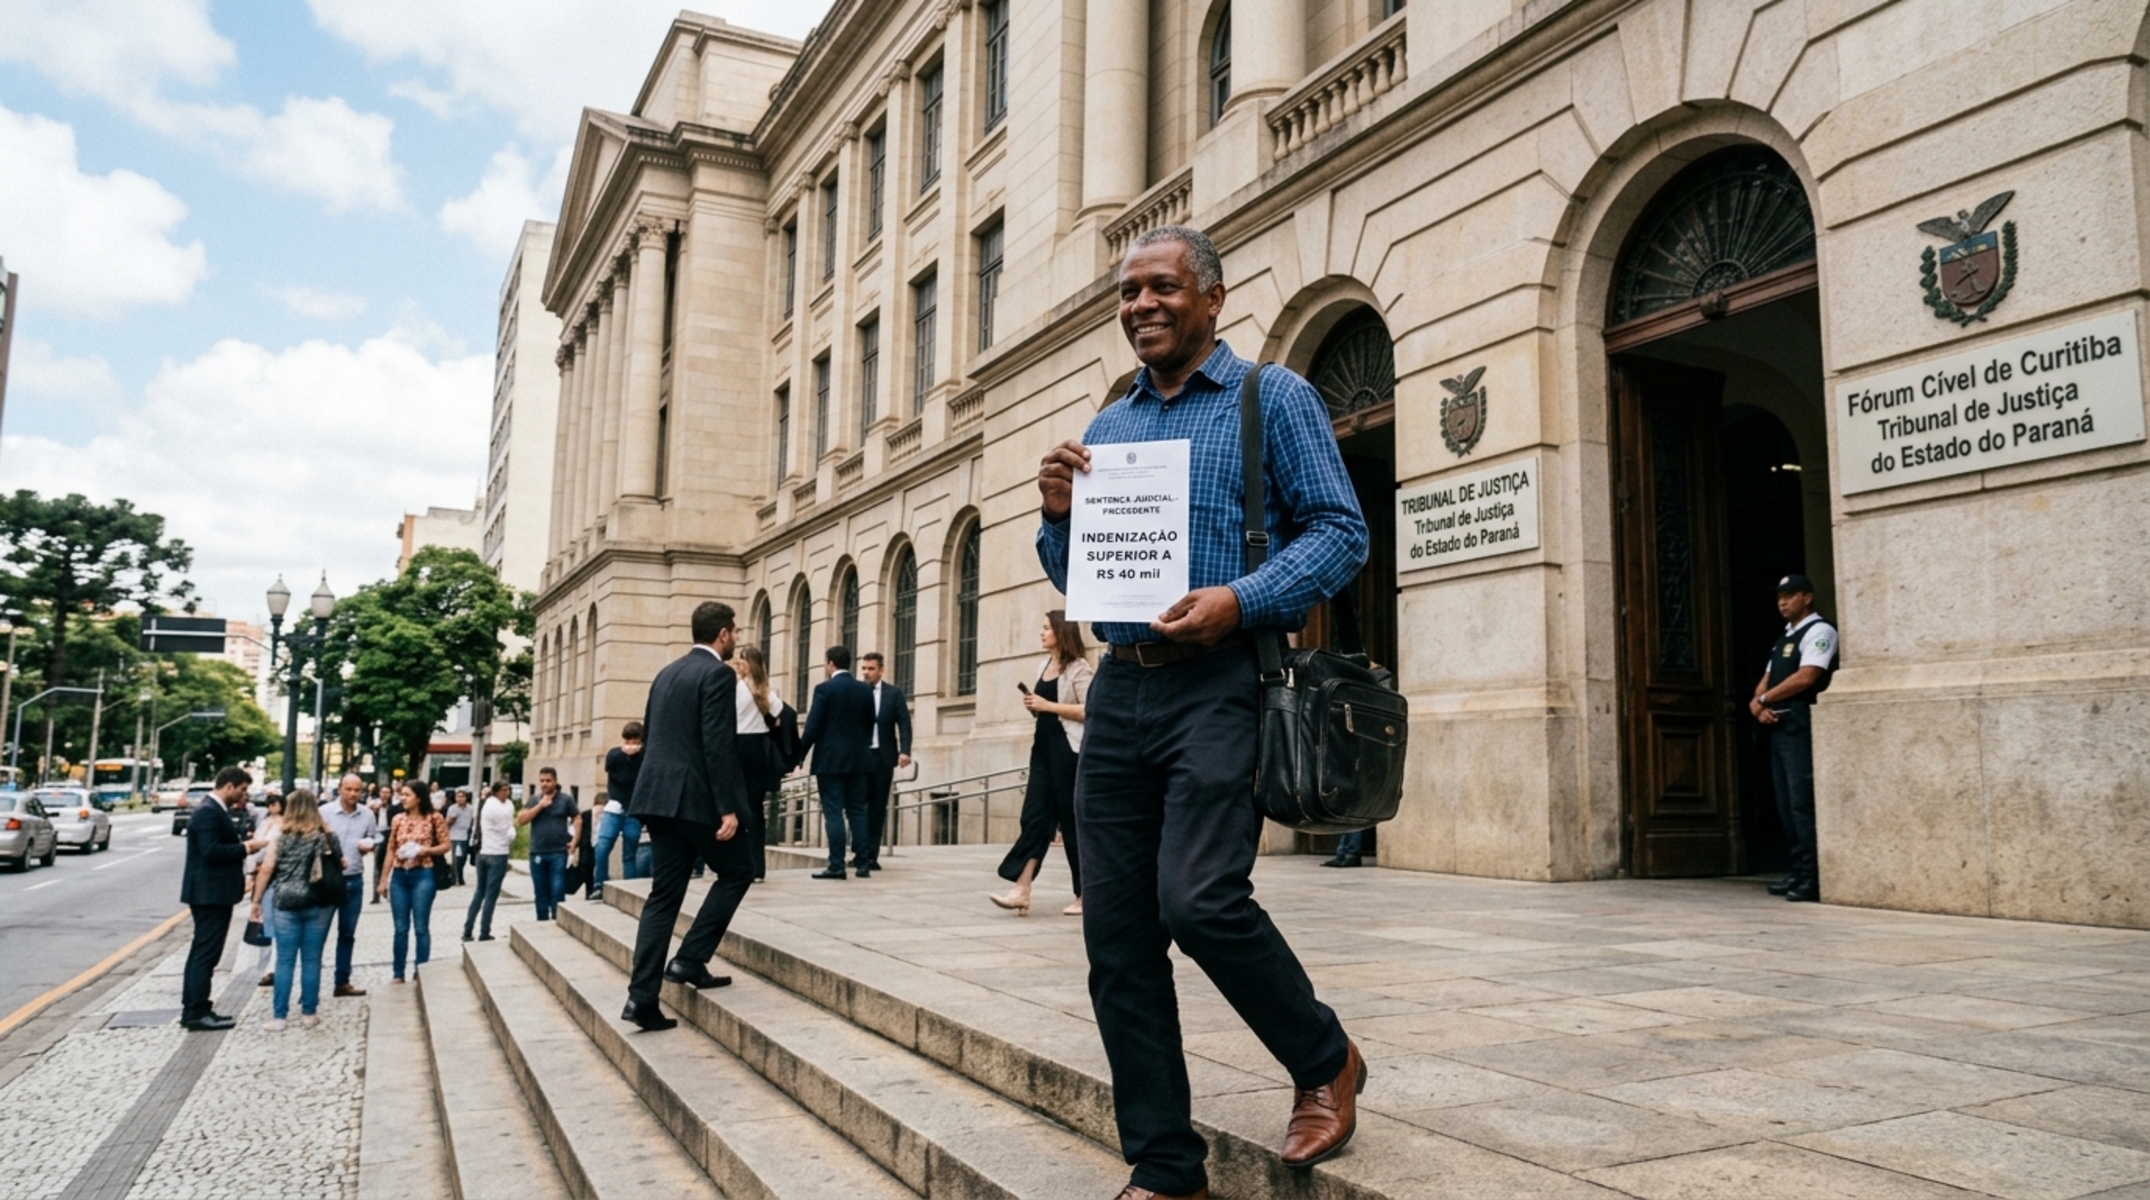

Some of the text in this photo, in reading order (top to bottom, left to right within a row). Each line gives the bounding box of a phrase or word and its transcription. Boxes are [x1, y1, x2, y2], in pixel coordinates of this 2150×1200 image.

[1847, 335, 2122, 417] Fórum Cível de Curitiba
[1877, 381, 2079, 440] Tribunal de Justiça
[1871, 407, 2094, 474] do Estado do Paraná
[1401, 470, 1530, 515] TRIBUNAL DE JUSTIÇA
[1082, 529, 1178, 544] INDENIZAÇÃO
[1414, 502, 1514, 535] Tribunal de Justiça
[1086, 549, 1172, 561] SUPERIOR A
[1410, 521, 1520, 559] do Estado do Paraná
[1119, 568, 1136, 579] 40
[1140, 567, 1160, 579] mil
